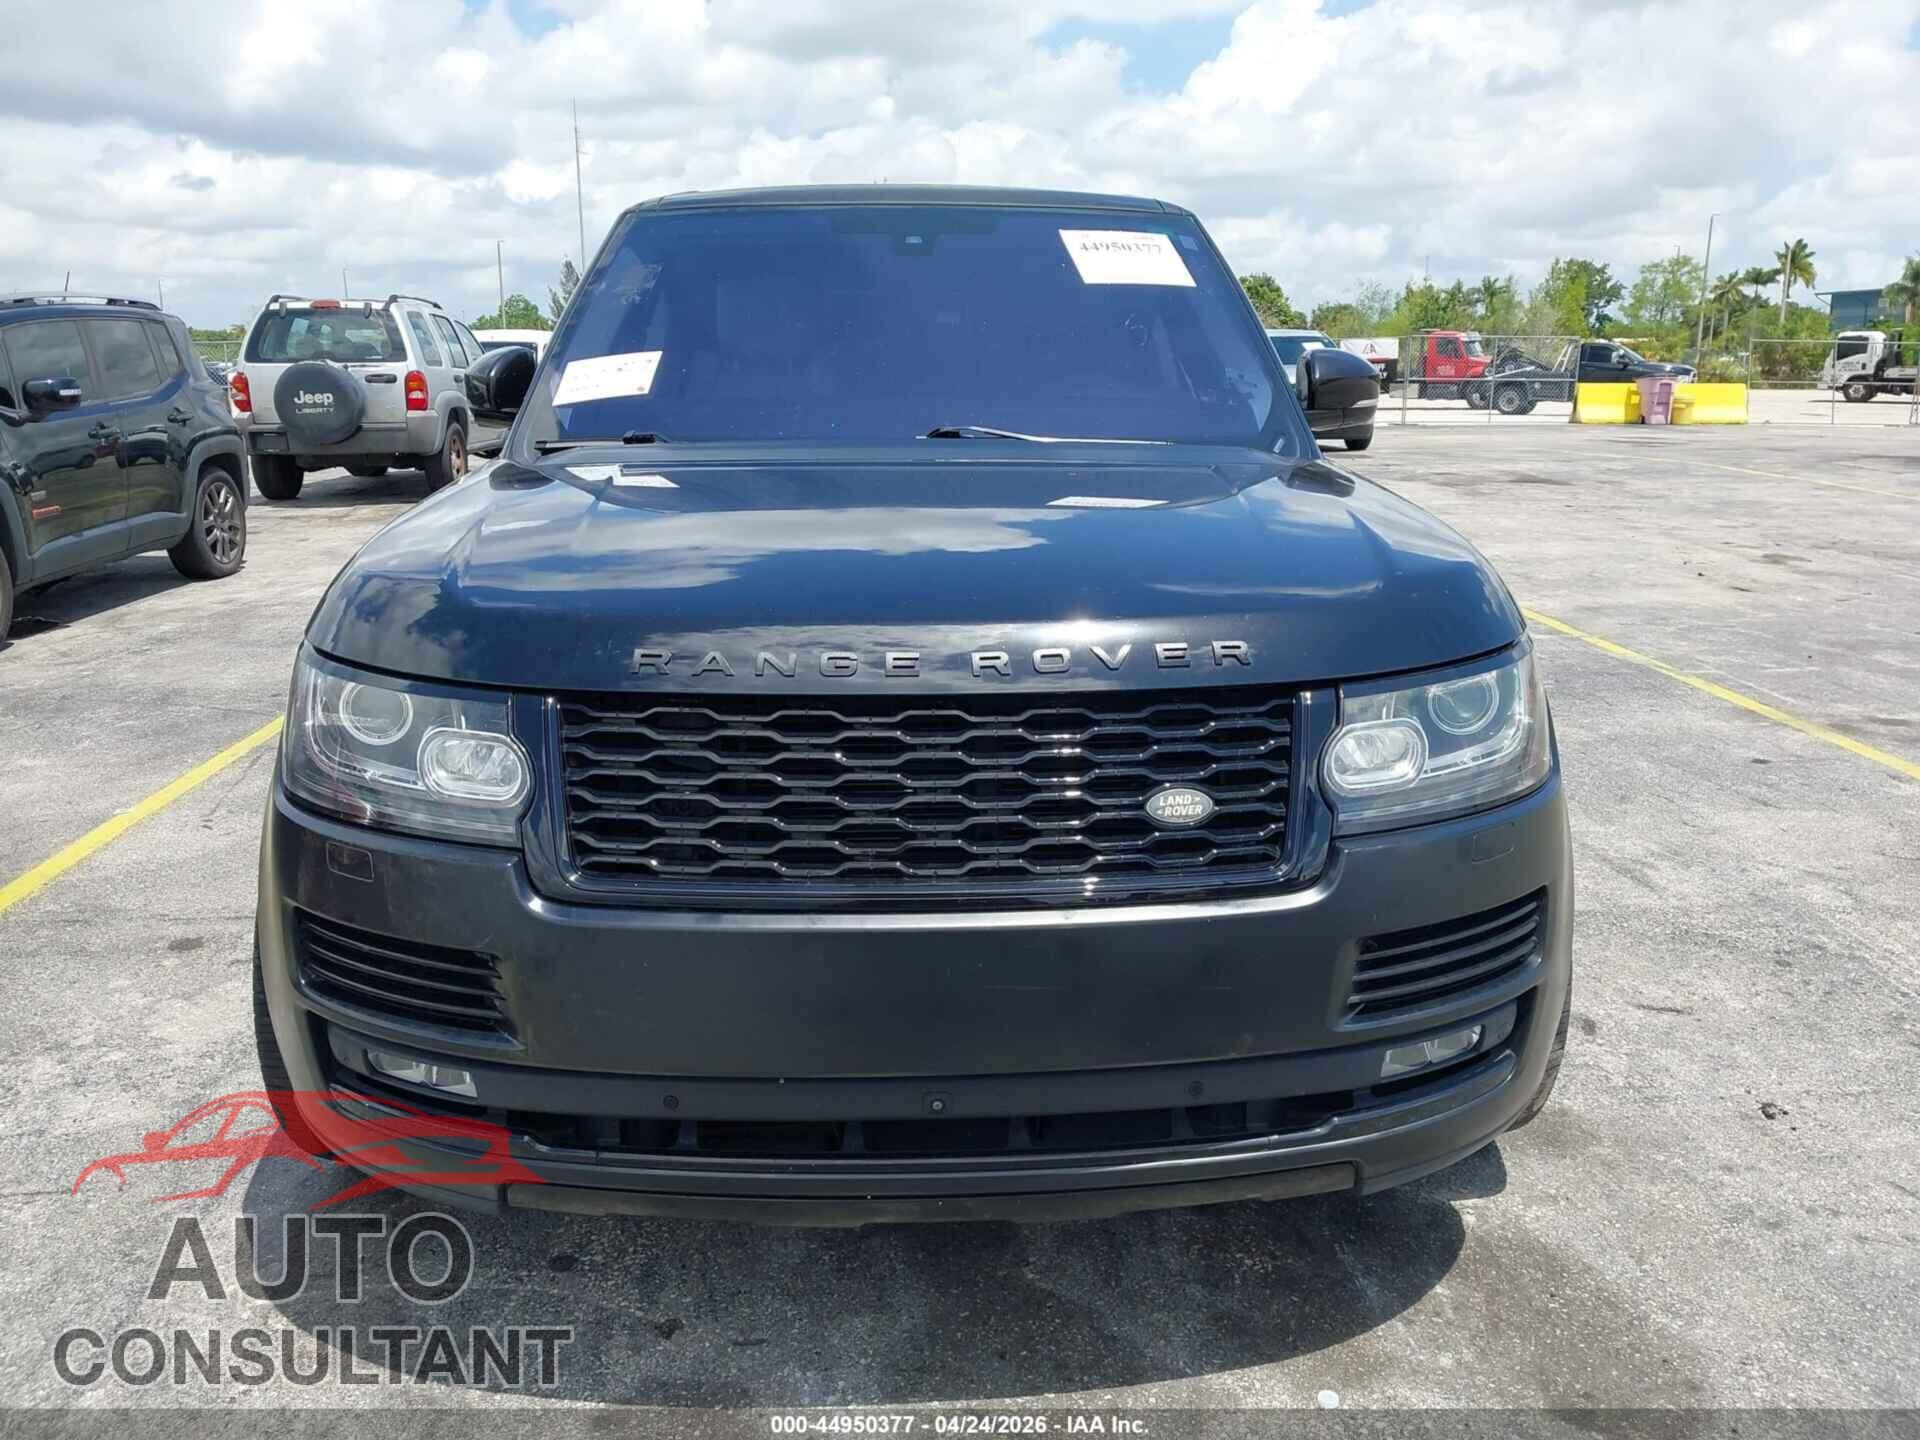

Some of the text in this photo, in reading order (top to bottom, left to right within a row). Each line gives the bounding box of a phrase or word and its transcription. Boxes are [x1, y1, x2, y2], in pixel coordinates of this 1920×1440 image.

[293, 390, 334, 406] Jeep
[296, 406, 334, 415] LIBERTY
[630, 641, 1252, 677] RANGE ROVER
[1159, 794, 1193, 807] LAND
[1164, 804, 1203, 817] ROVER
